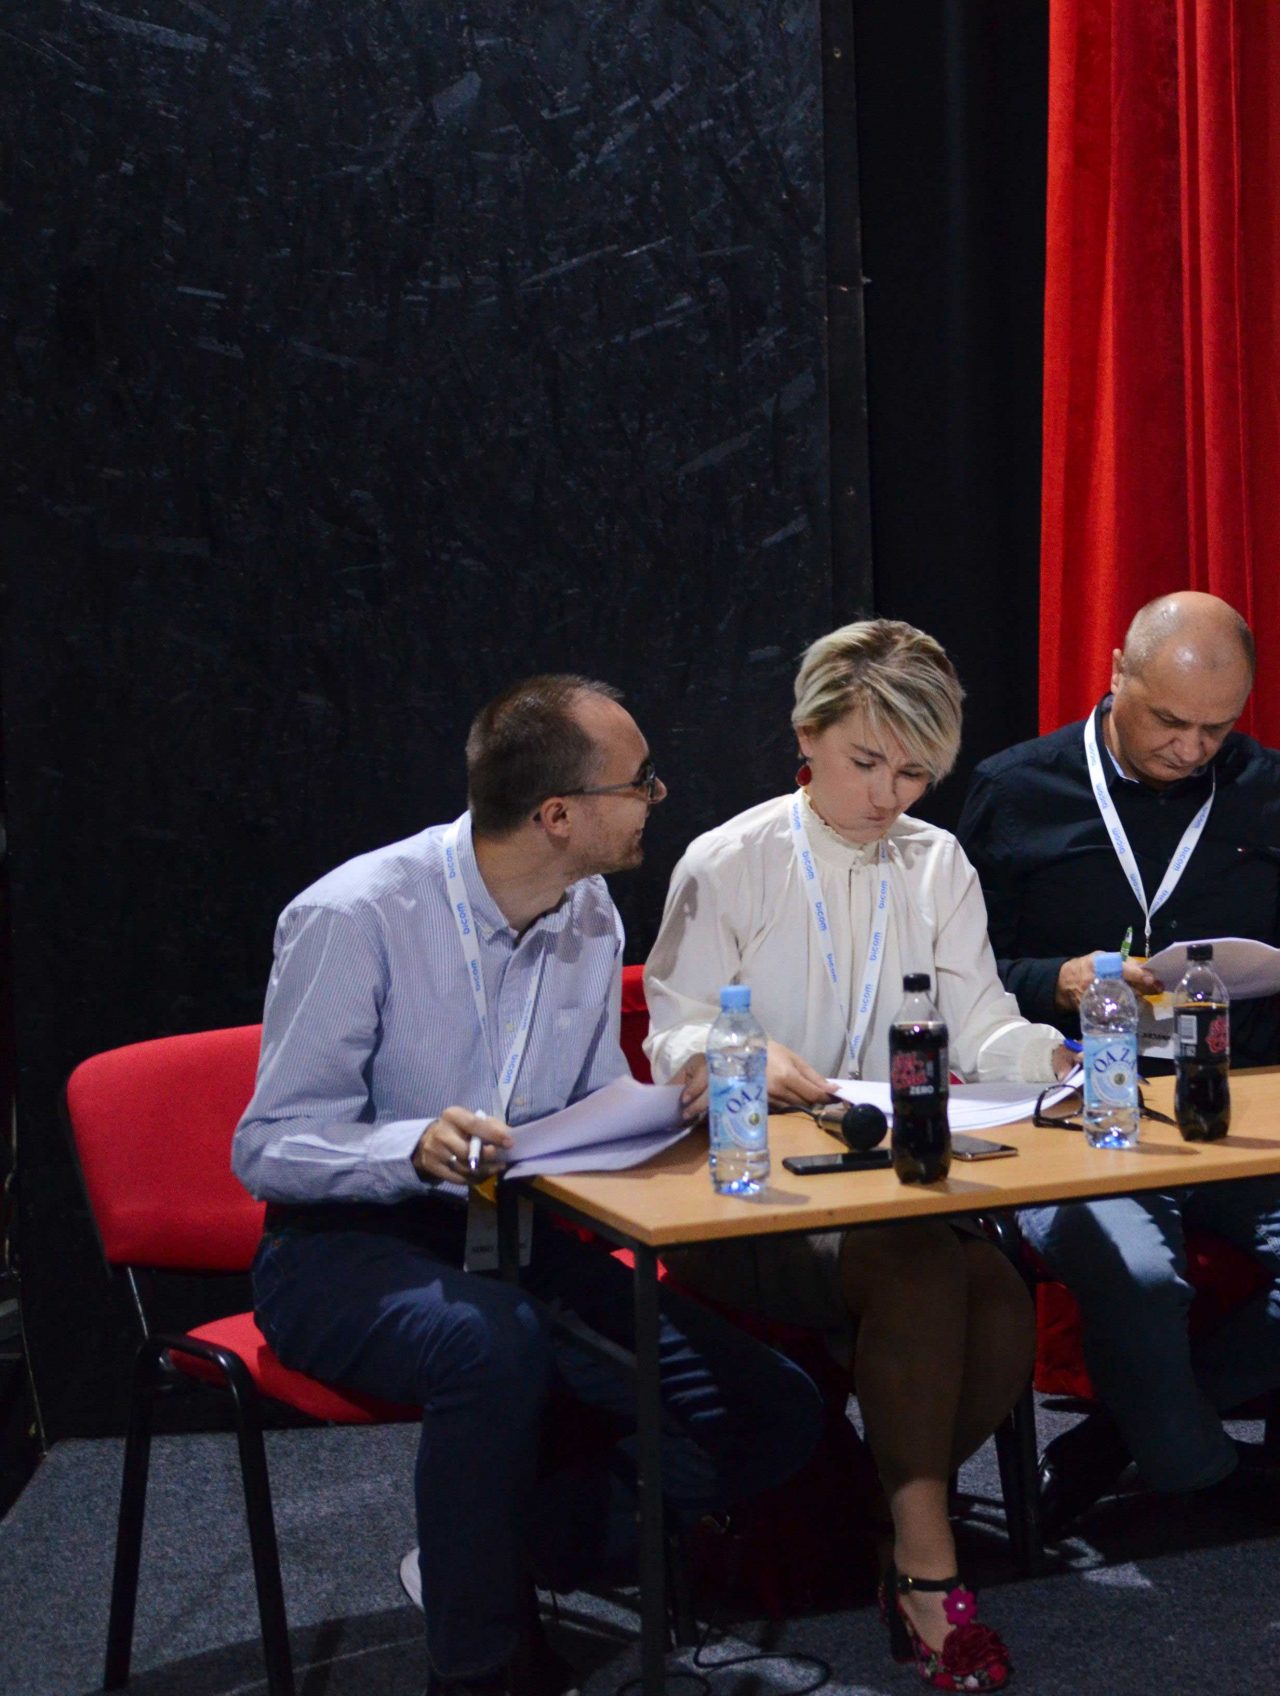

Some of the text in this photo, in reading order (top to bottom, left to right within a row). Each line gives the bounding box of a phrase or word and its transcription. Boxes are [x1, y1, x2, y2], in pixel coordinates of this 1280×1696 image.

[802, 851, 815, 880] bicom
[878, 880, 888, 909] bicom
[815, 902, 828, 931] bicom
[870, 932, 881, 961] bicom
[860, 984, 872, 1013] bicom
